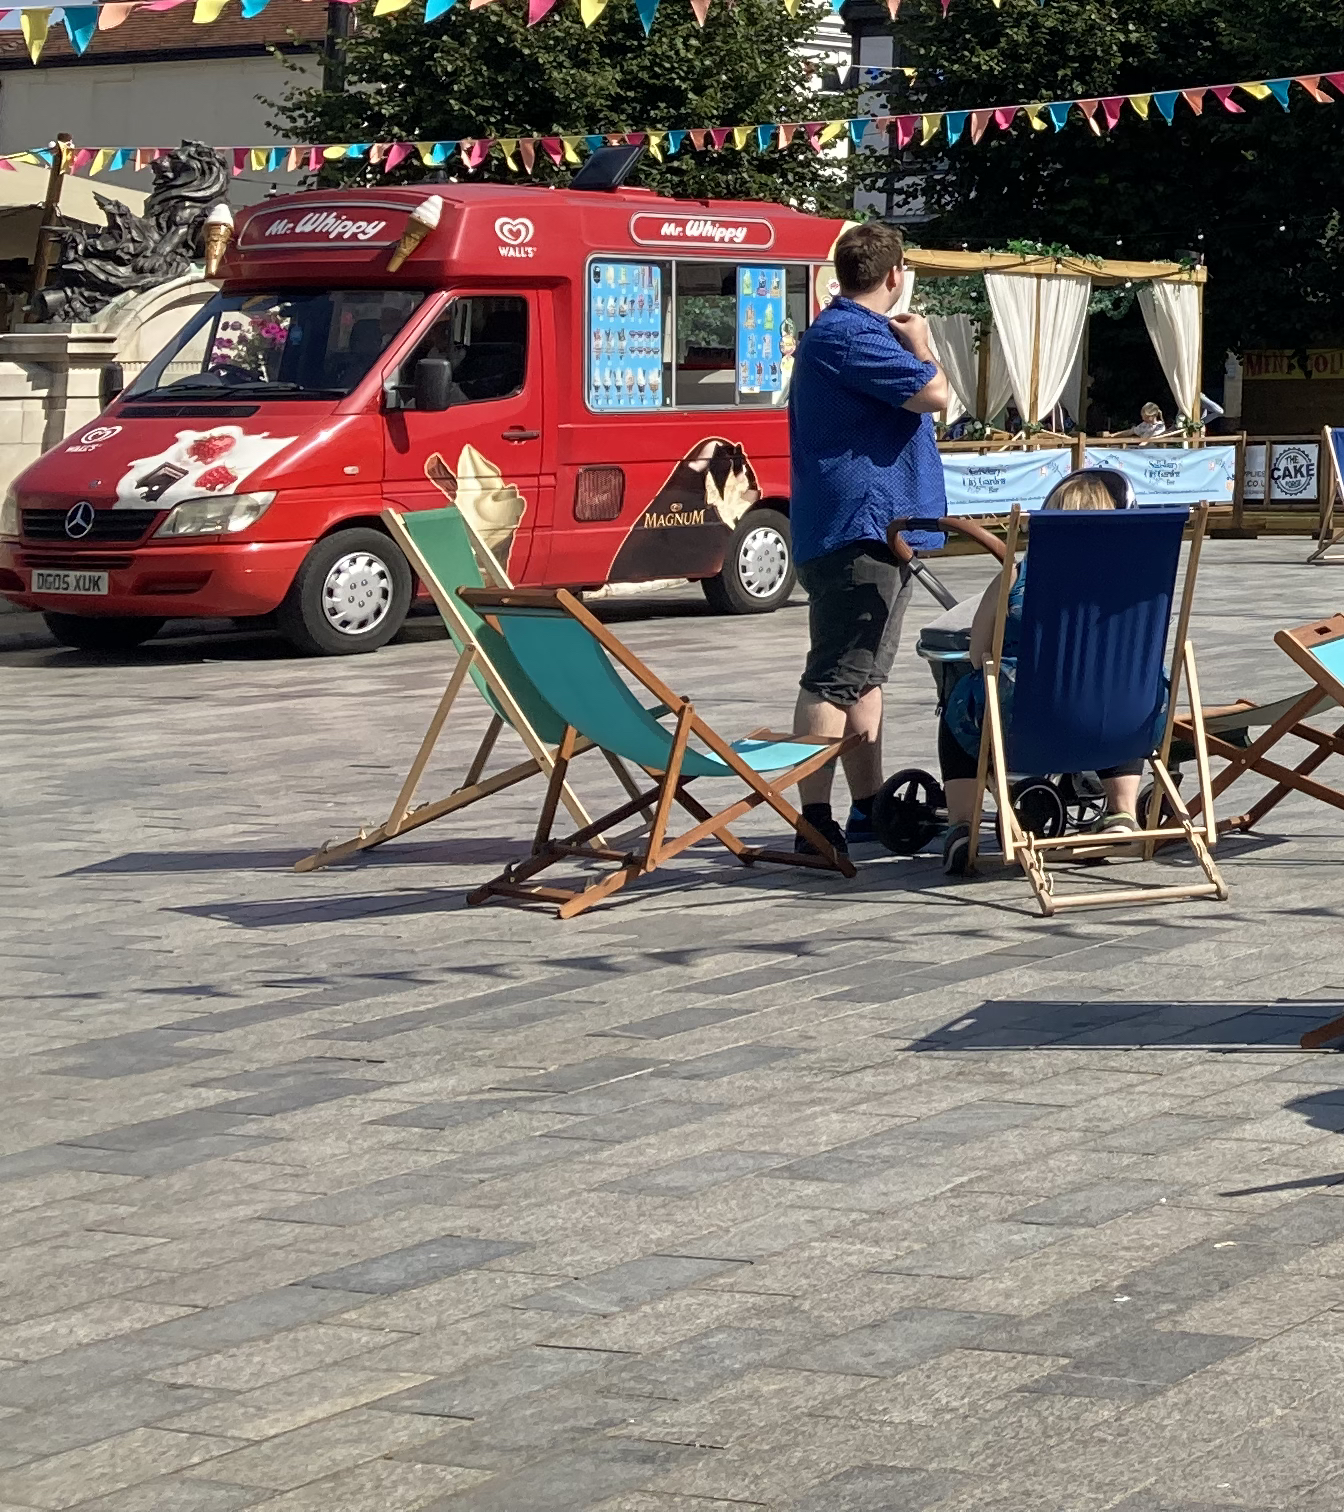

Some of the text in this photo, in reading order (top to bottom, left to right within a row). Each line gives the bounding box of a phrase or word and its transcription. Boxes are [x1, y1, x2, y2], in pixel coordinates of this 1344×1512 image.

[265, 212, 386, 240] Mr. Whippy
[660, 220, 747, 243] Mr. Whippy
[498, 246, 535, 258] WALL'S
[1285, 455, 1299, 464] THE
[1271, 463, 1315, 480] CAKE
[644, 509, 706, 528] MAGNUM
[37, 573, 102, 592] DG05 XUK
